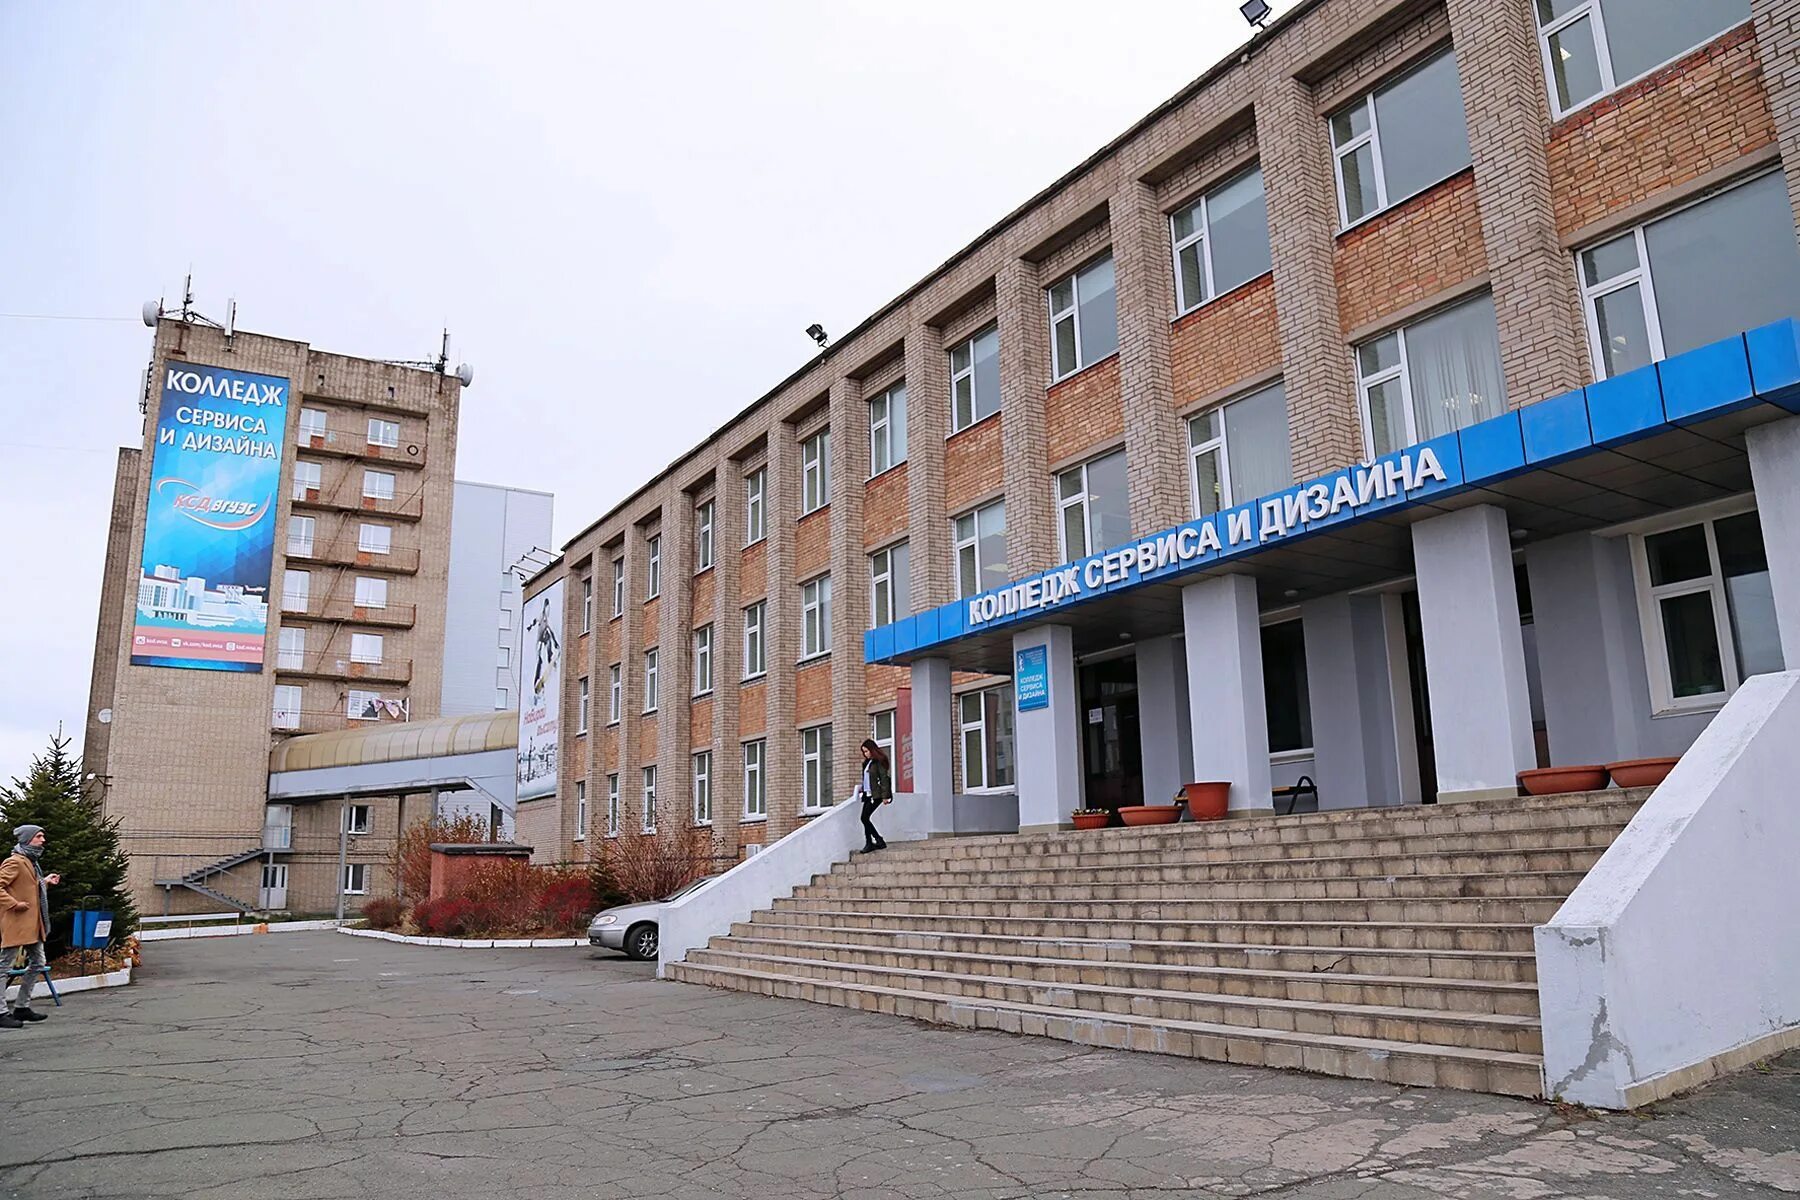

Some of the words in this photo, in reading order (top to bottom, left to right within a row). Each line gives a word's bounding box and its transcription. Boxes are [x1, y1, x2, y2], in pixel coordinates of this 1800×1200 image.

[166, 369, 284, 407] КОЛЛЕДЖ
[176, 406, 268, 435] СЕРВИСА
[160, 427, 177, 445] И
[182, 432, 278, 460] ДИЗАЙНА
[968, 564, 1081, 626] КОЛЛЕДЖ
[1084, 520, 1222, 588] СЕРВИСА
[1227, 511, 1252, 546] И
[1259, 447, 1448, 542] ДИЗАЙНА
[1020, 682, 1043, 692] СЕРВИСА
